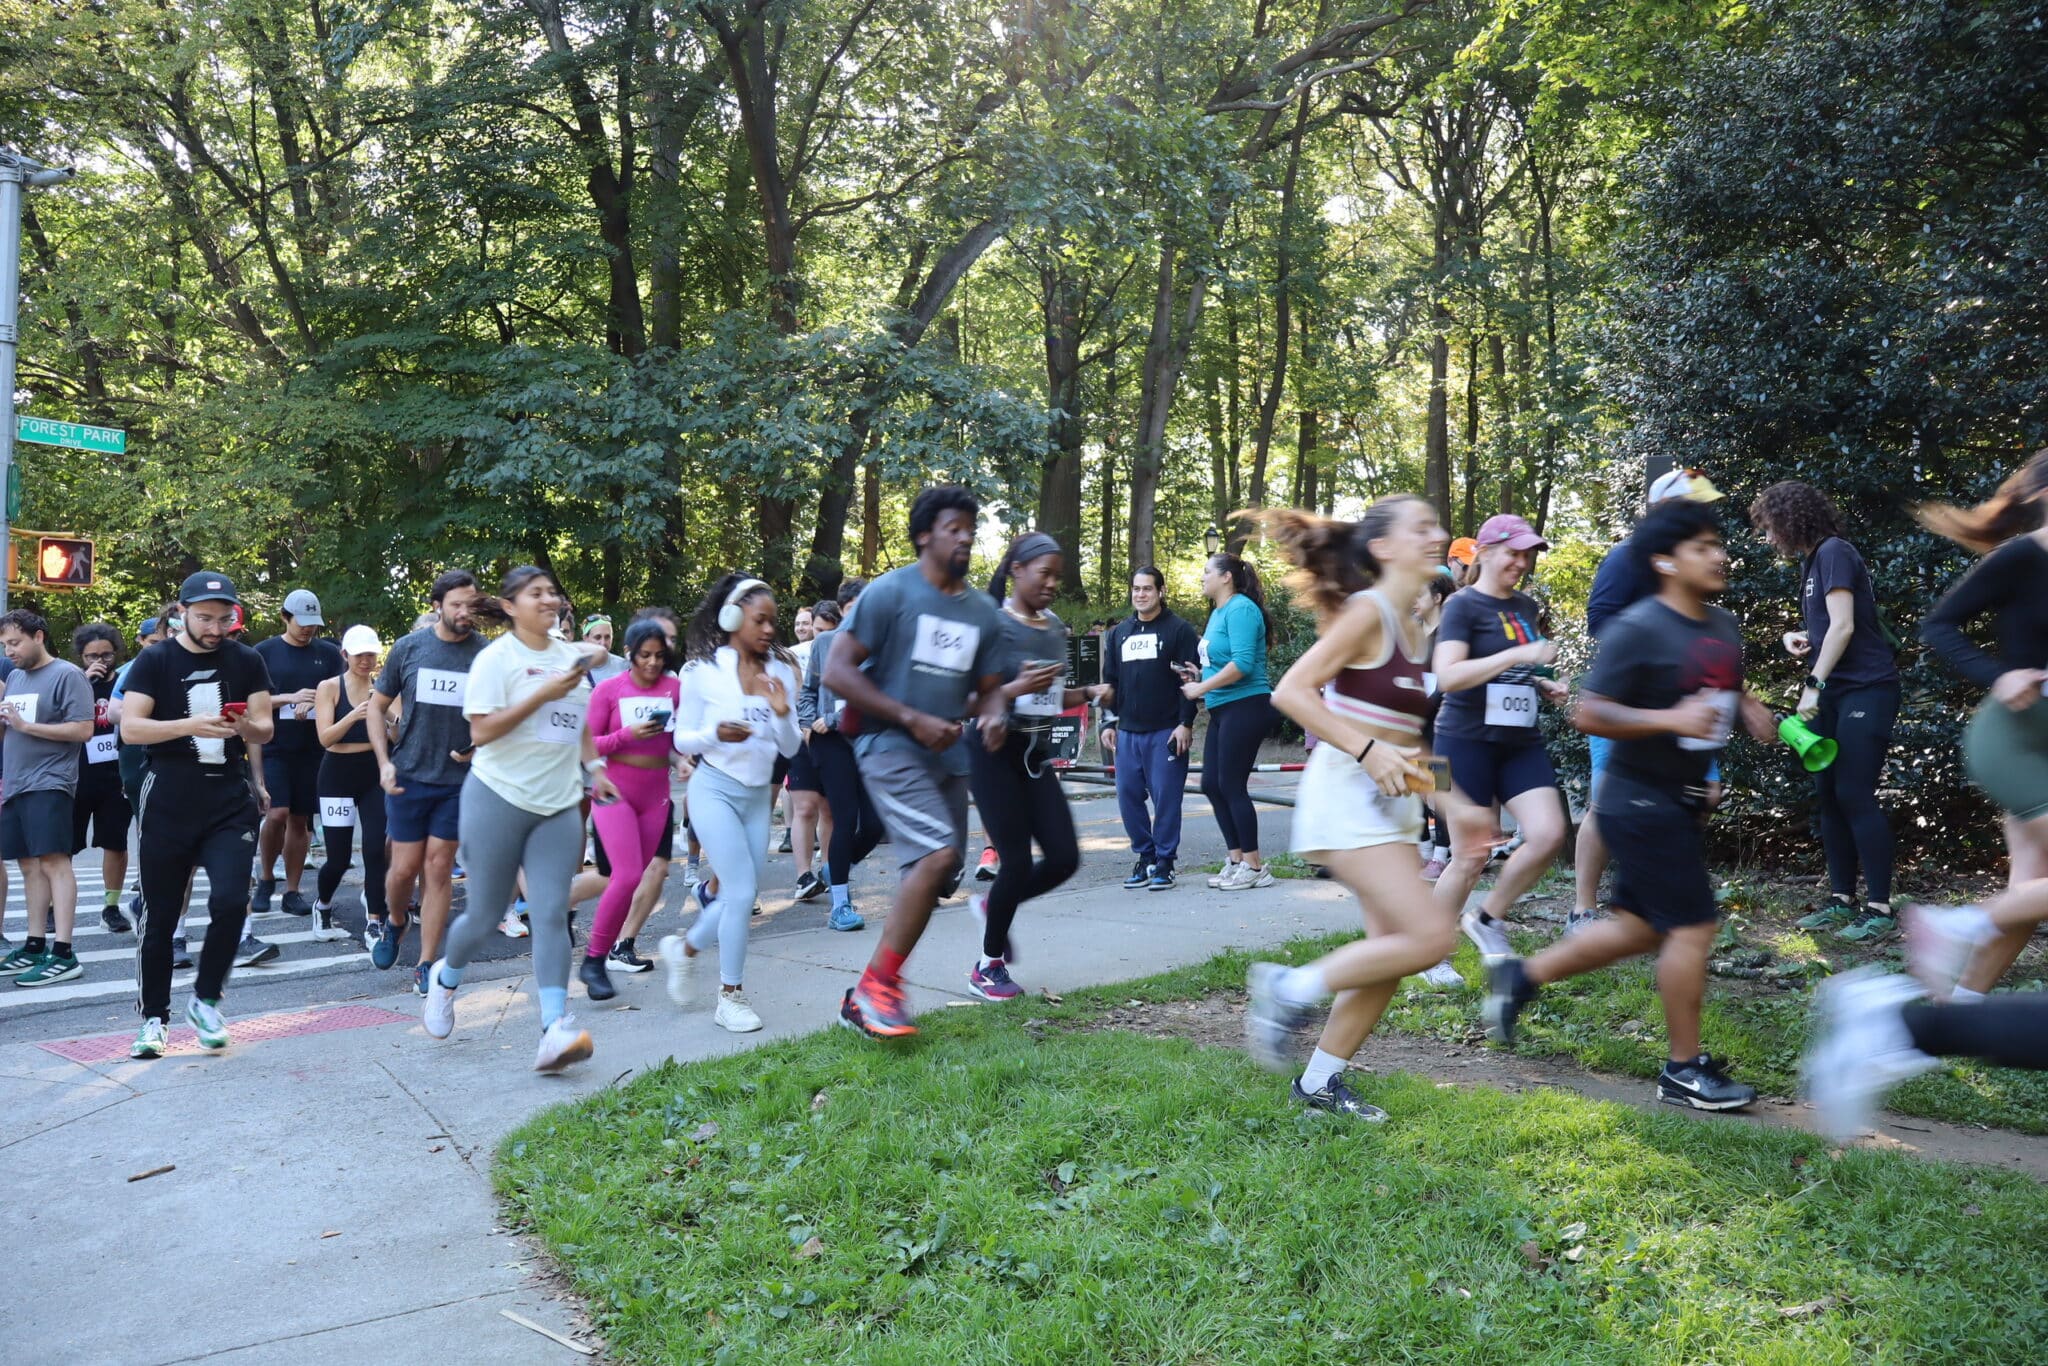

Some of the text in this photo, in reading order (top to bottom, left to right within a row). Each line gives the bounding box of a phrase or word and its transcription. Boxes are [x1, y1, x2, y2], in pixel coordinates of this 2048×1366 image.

[20, 419, 120, 444] FOREST PARK
[60, 438, 82, 446] DRIVE
[1130, 640, 1149, 651] 024
[430, 678, 457, 693] 112
[1503, 696, 1530, 712] 003
[551, 711, 578, 730] 092
[327, 806, 350, 817] 045
